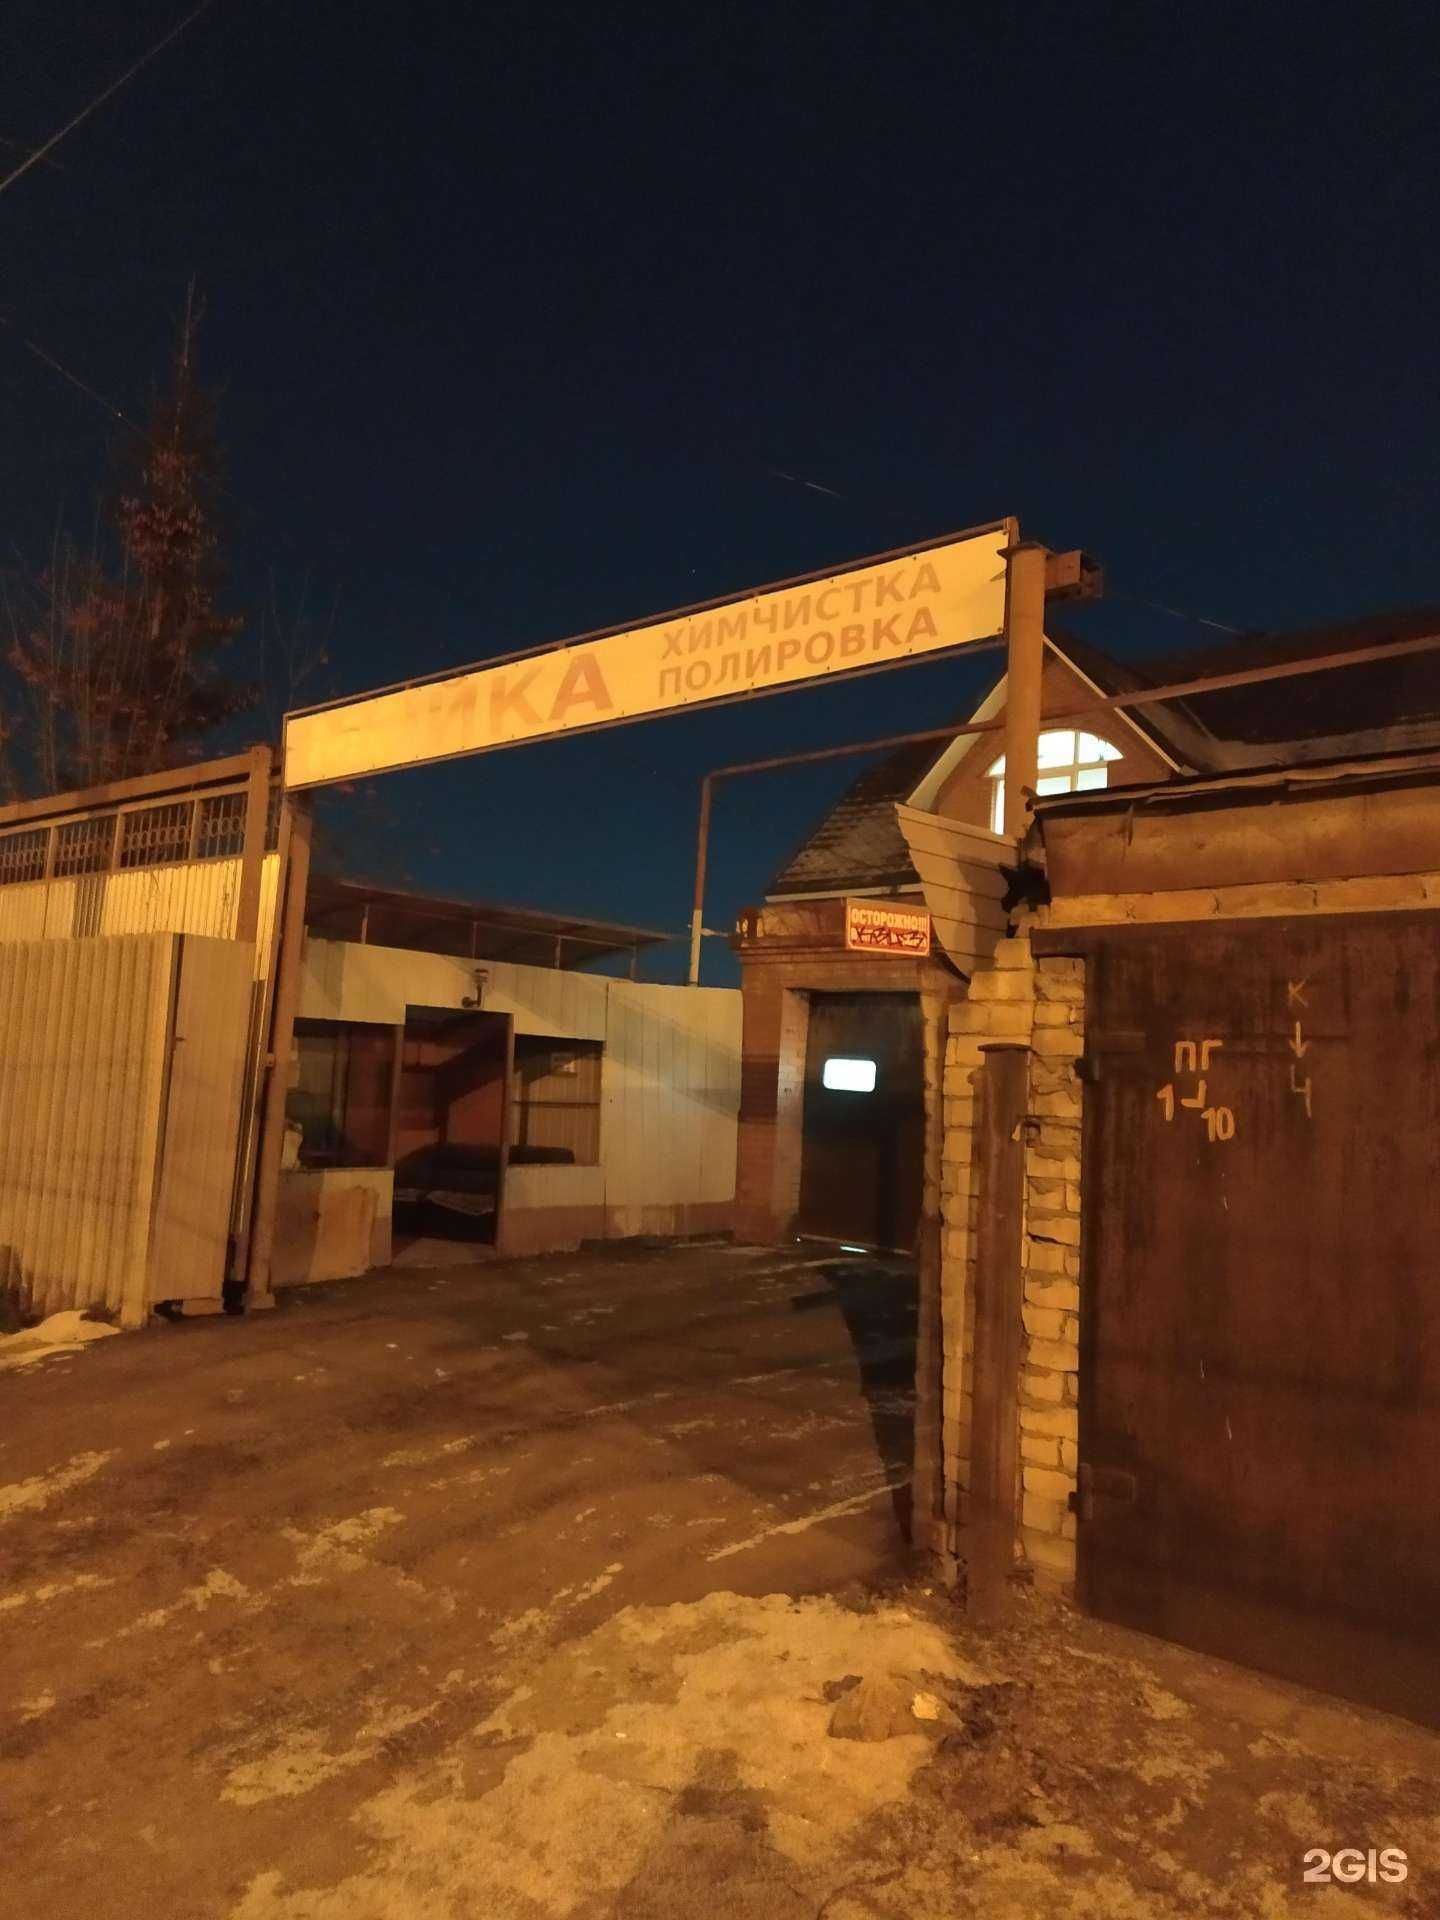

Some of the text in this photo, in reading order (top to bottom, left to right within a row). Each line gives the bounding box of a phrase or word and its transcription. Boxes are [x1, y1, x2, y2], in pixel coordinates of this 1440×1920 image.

[661, 562, 941, 660] ХИМЧИСТКА
[658, 606, 938, 698] ПОЛИРОВКА
[1174, 1039, 1223, 1074] ПГ
[1156, 1083, 1175, 1121] 1
[1201, 1106, 1235, 1142] 10
